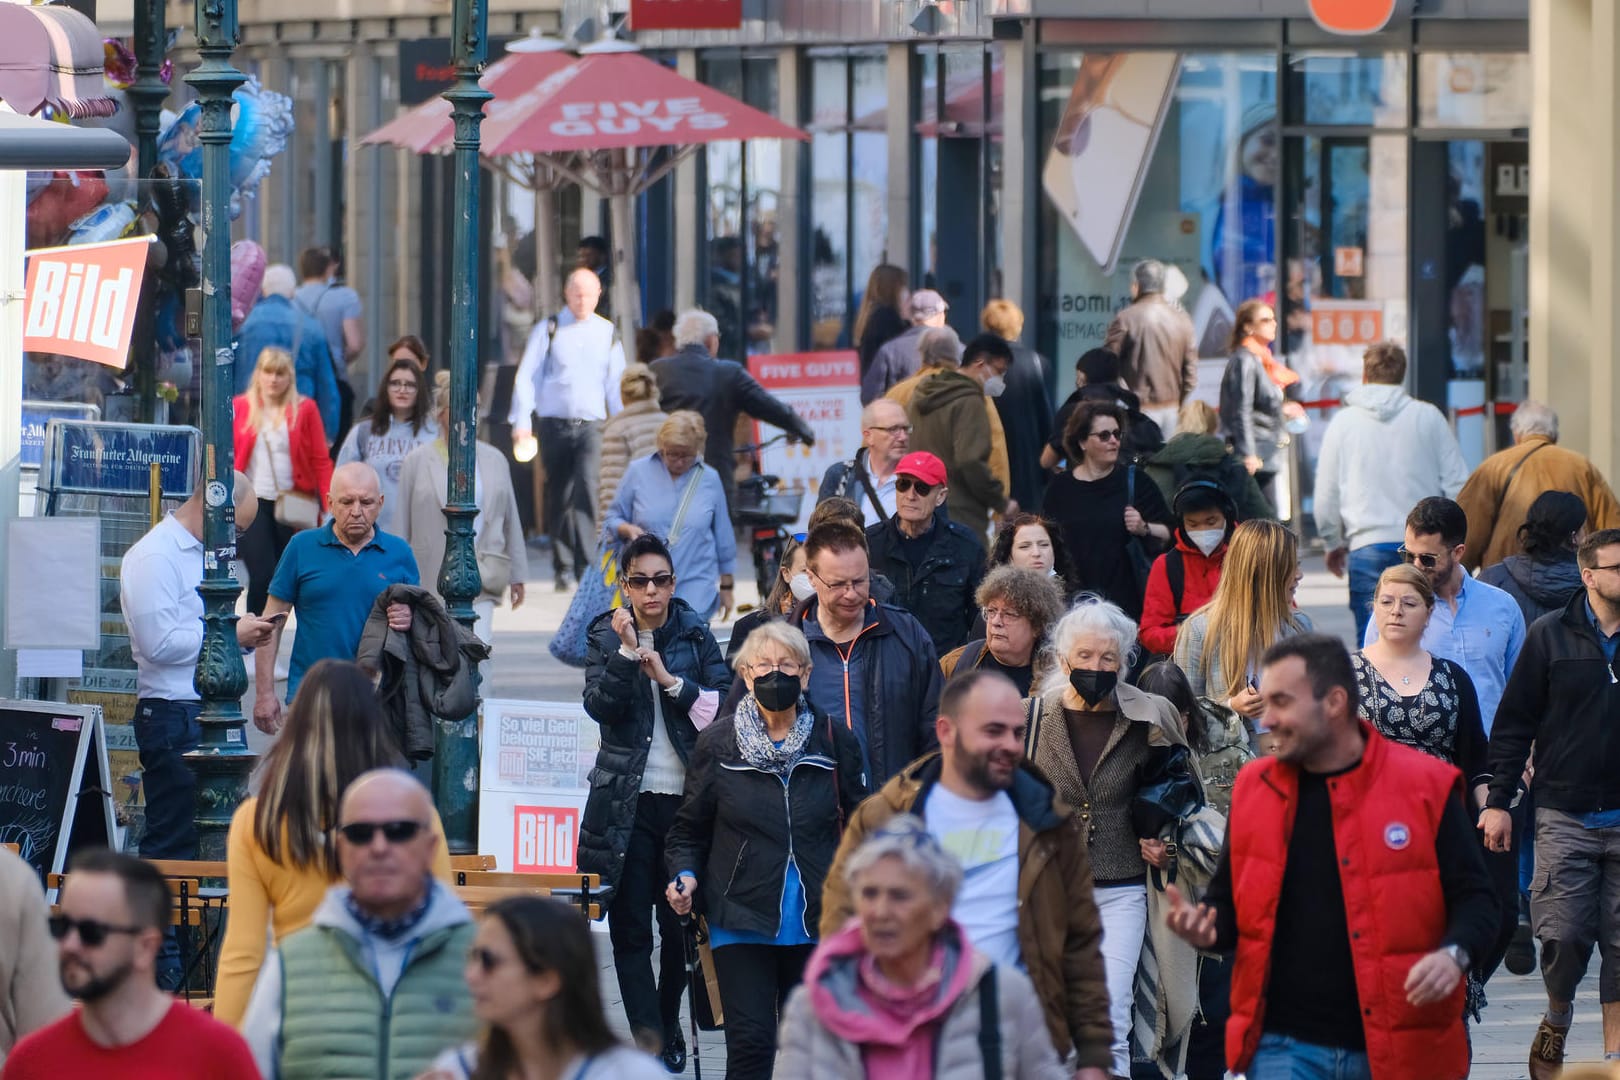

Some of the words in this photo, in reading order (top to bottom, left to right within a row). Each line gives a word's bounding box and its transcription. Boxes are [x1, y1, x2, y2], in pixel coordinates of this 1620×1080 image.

[560, 97, 702, 120] FIVE
[549, 113, 729, 136] GUYS
[25, 260, 134, 351] Bild
[760, 363, 801, 379] FIVE
[806, 361, 856, 377] GUYS
[126, 448, 181, 465] Allgemeine
[83, 675, 107, 689] DIE
[501, 716, 518, 732] So
[521, 717, 545, 733] viel
[549, 719, 577, 735] Geld
[501, 731, 577, 748] bekommen
[528, 748, 547, 762] SIE
[549, 749, 577, 764] jetzt
[518, 812, 574, 868] Bild
